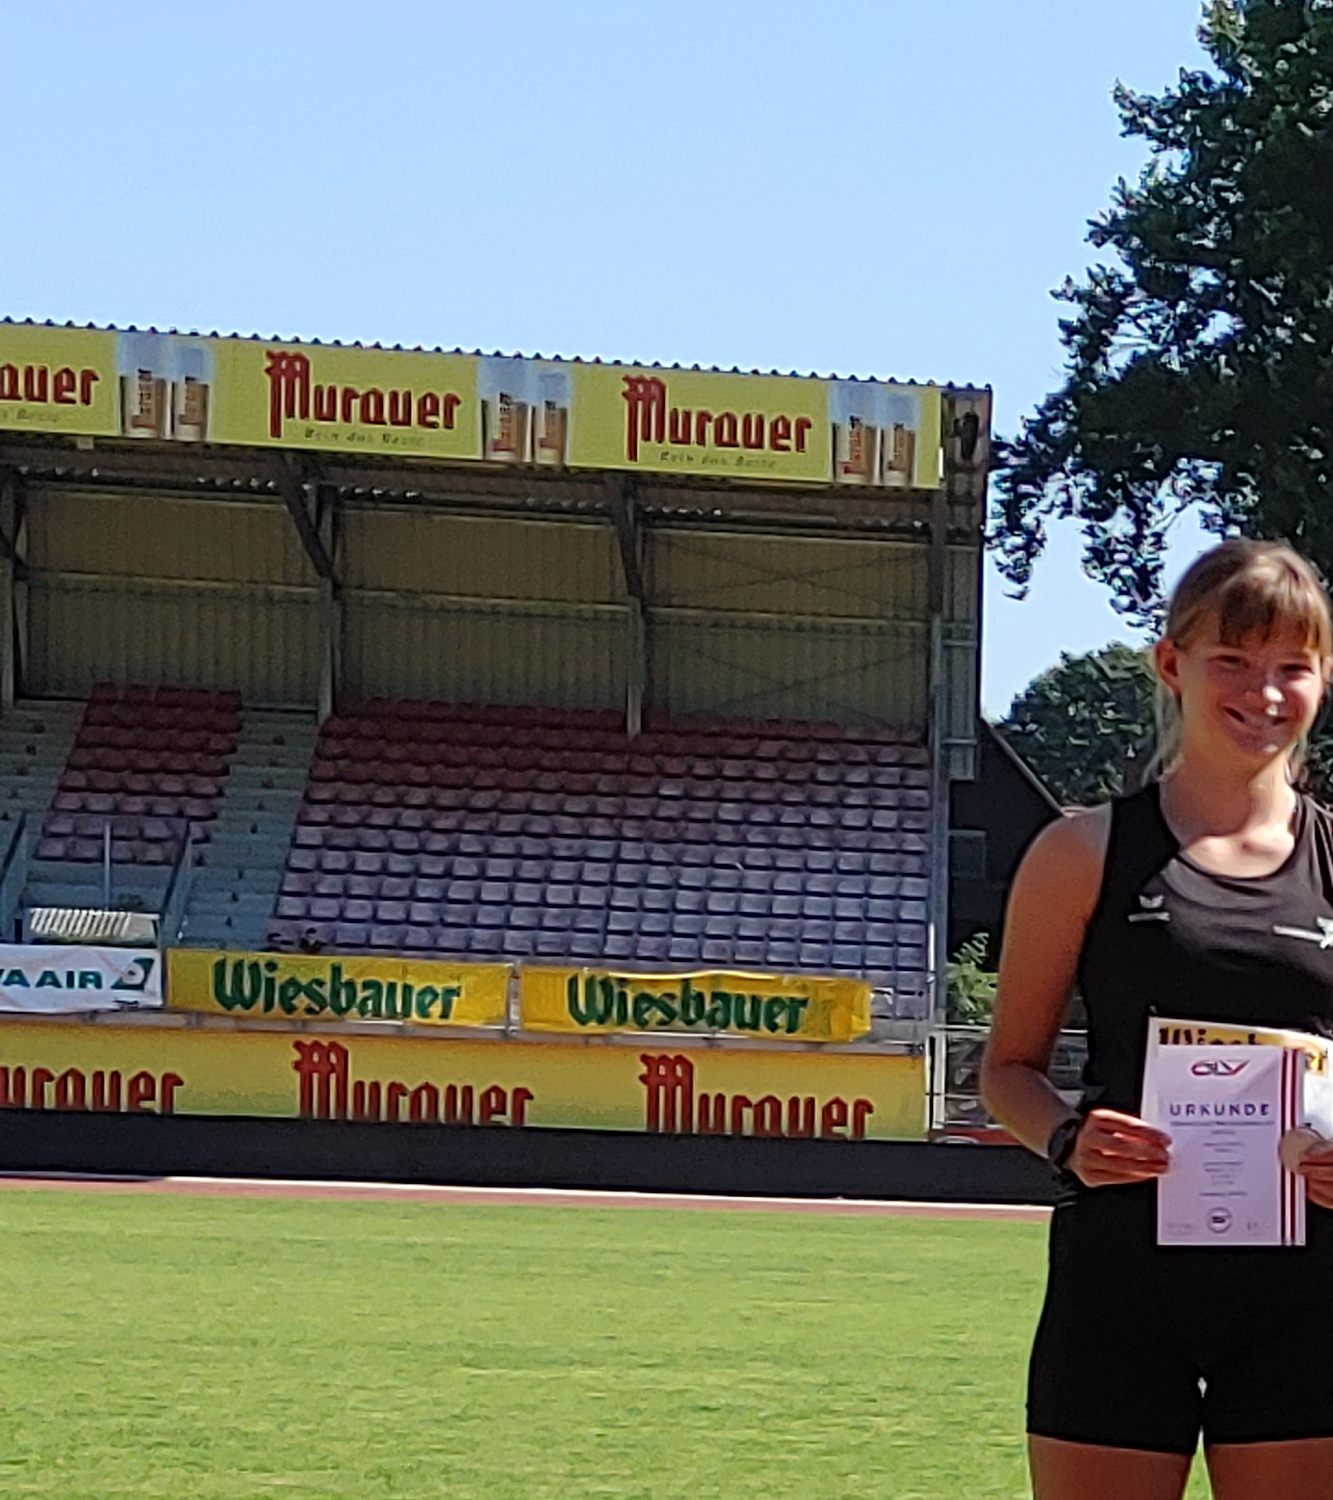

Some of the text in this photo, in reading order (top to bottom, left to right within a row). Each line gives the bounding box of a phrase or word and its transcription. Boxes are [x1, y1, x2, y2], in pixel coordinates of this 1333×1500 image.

[264, 350, 462, 438] Murauer
[622, 374, 812, 462] Murauer
[35, 970, 103, 989] AIR
[213, 957, 462, 1021] Wiesbauer
[567, 972, 810, 1034] Wiesbauer
[292, 1039, 534, 1126] Murauer
[638, 1053, 875, 1140] Murauer
[1169, 1103, 1271, 1117] URKUNDE
